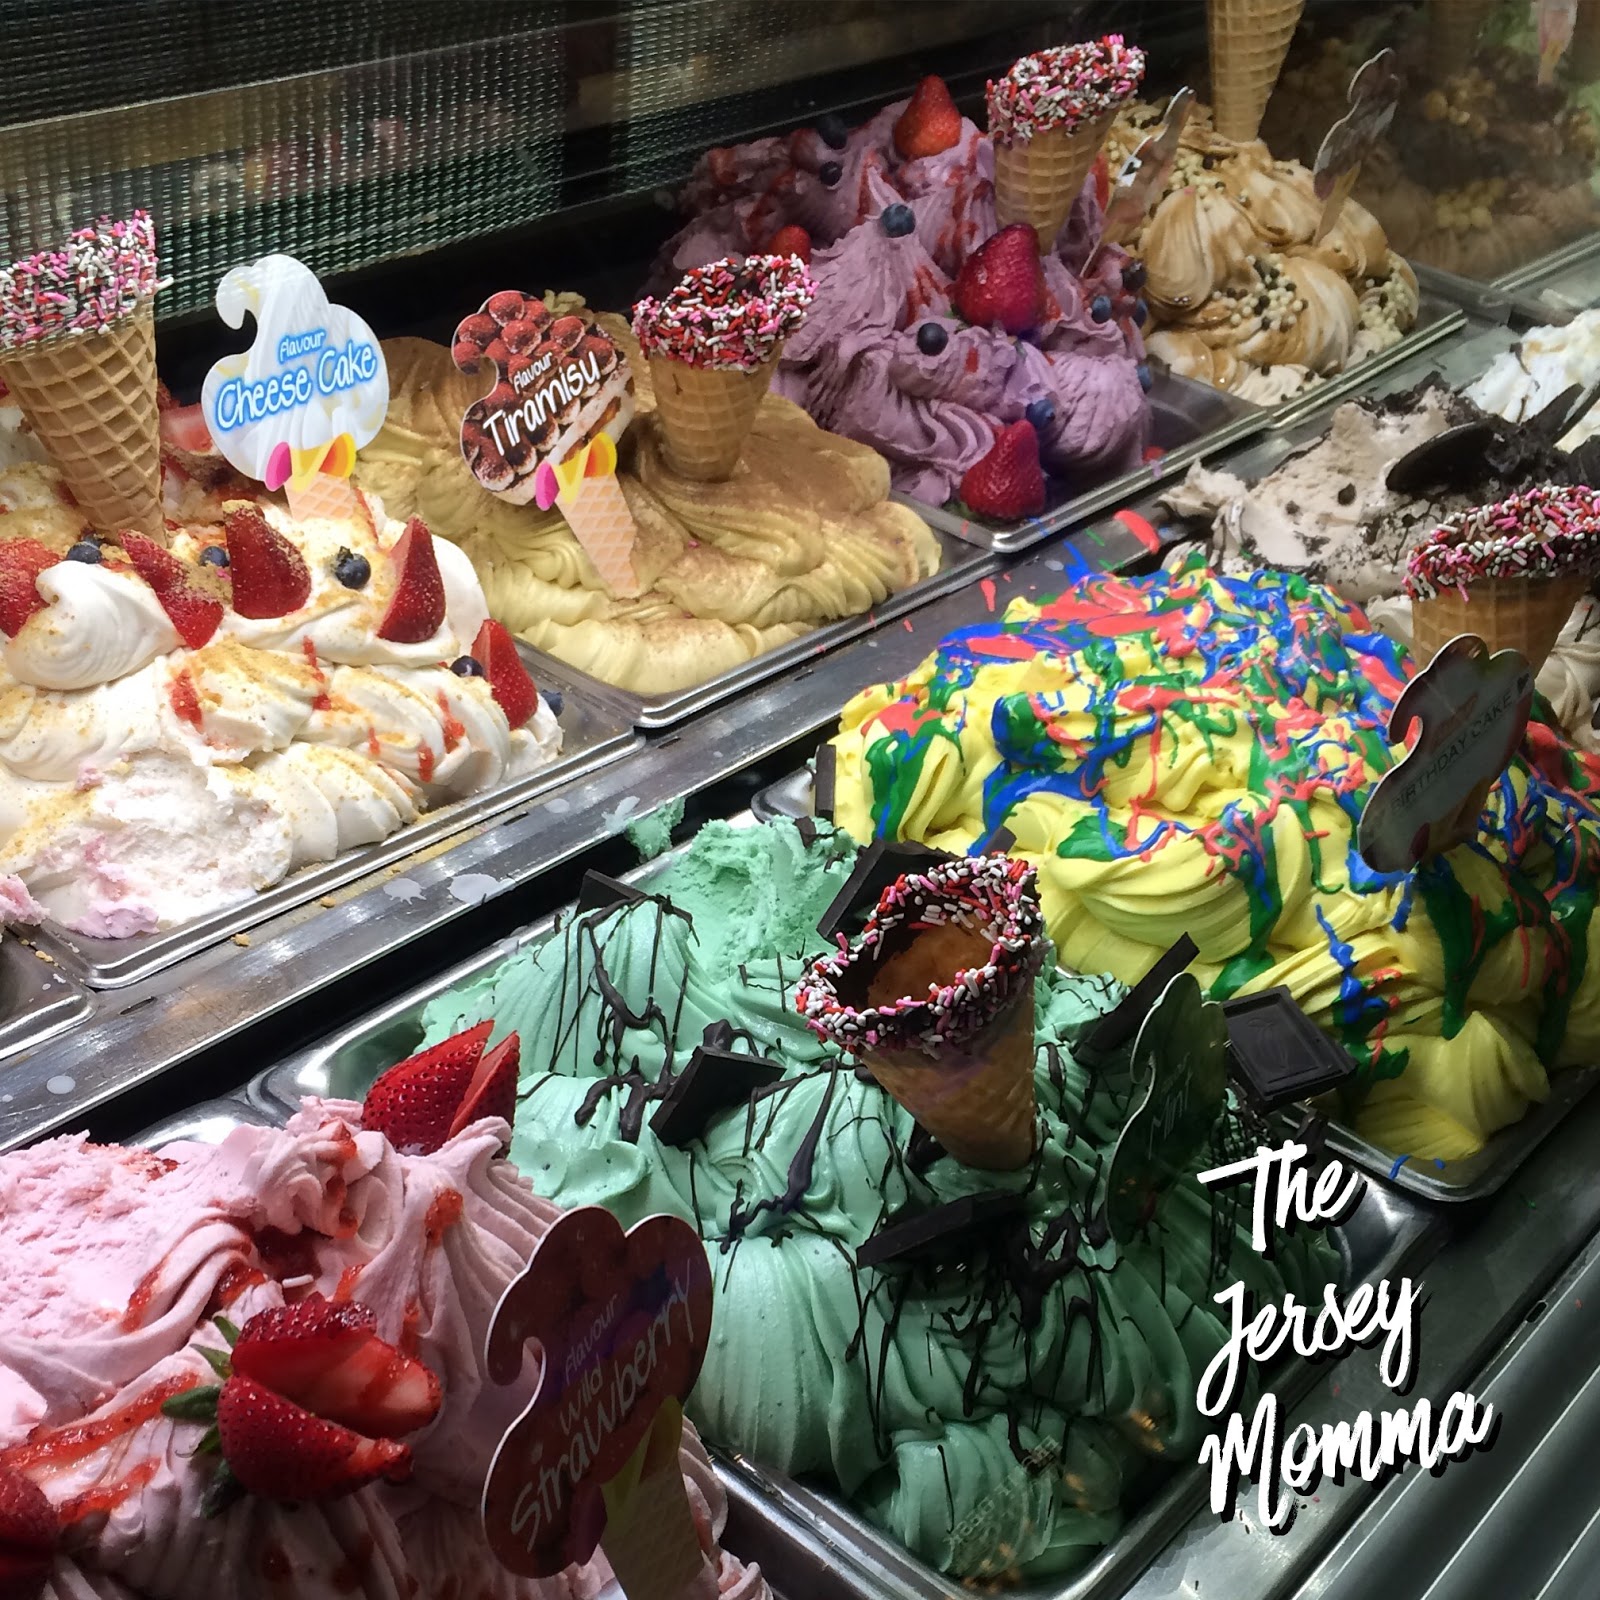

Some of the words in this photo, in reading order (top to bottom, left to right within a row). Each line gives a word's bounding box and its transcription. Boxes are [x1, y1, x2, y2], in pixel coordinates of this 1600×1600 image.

[215, 369, 312, 431] Cheese
[319, 342, 377, 394] Cake
[482, 350, 601, 456] Tiramisu
[1389, 735, 1469, 815] BIRTHDAY
[1471, 692, 1514, 739] CAKE
[510, 1257, 695, 1554] Strawberry
